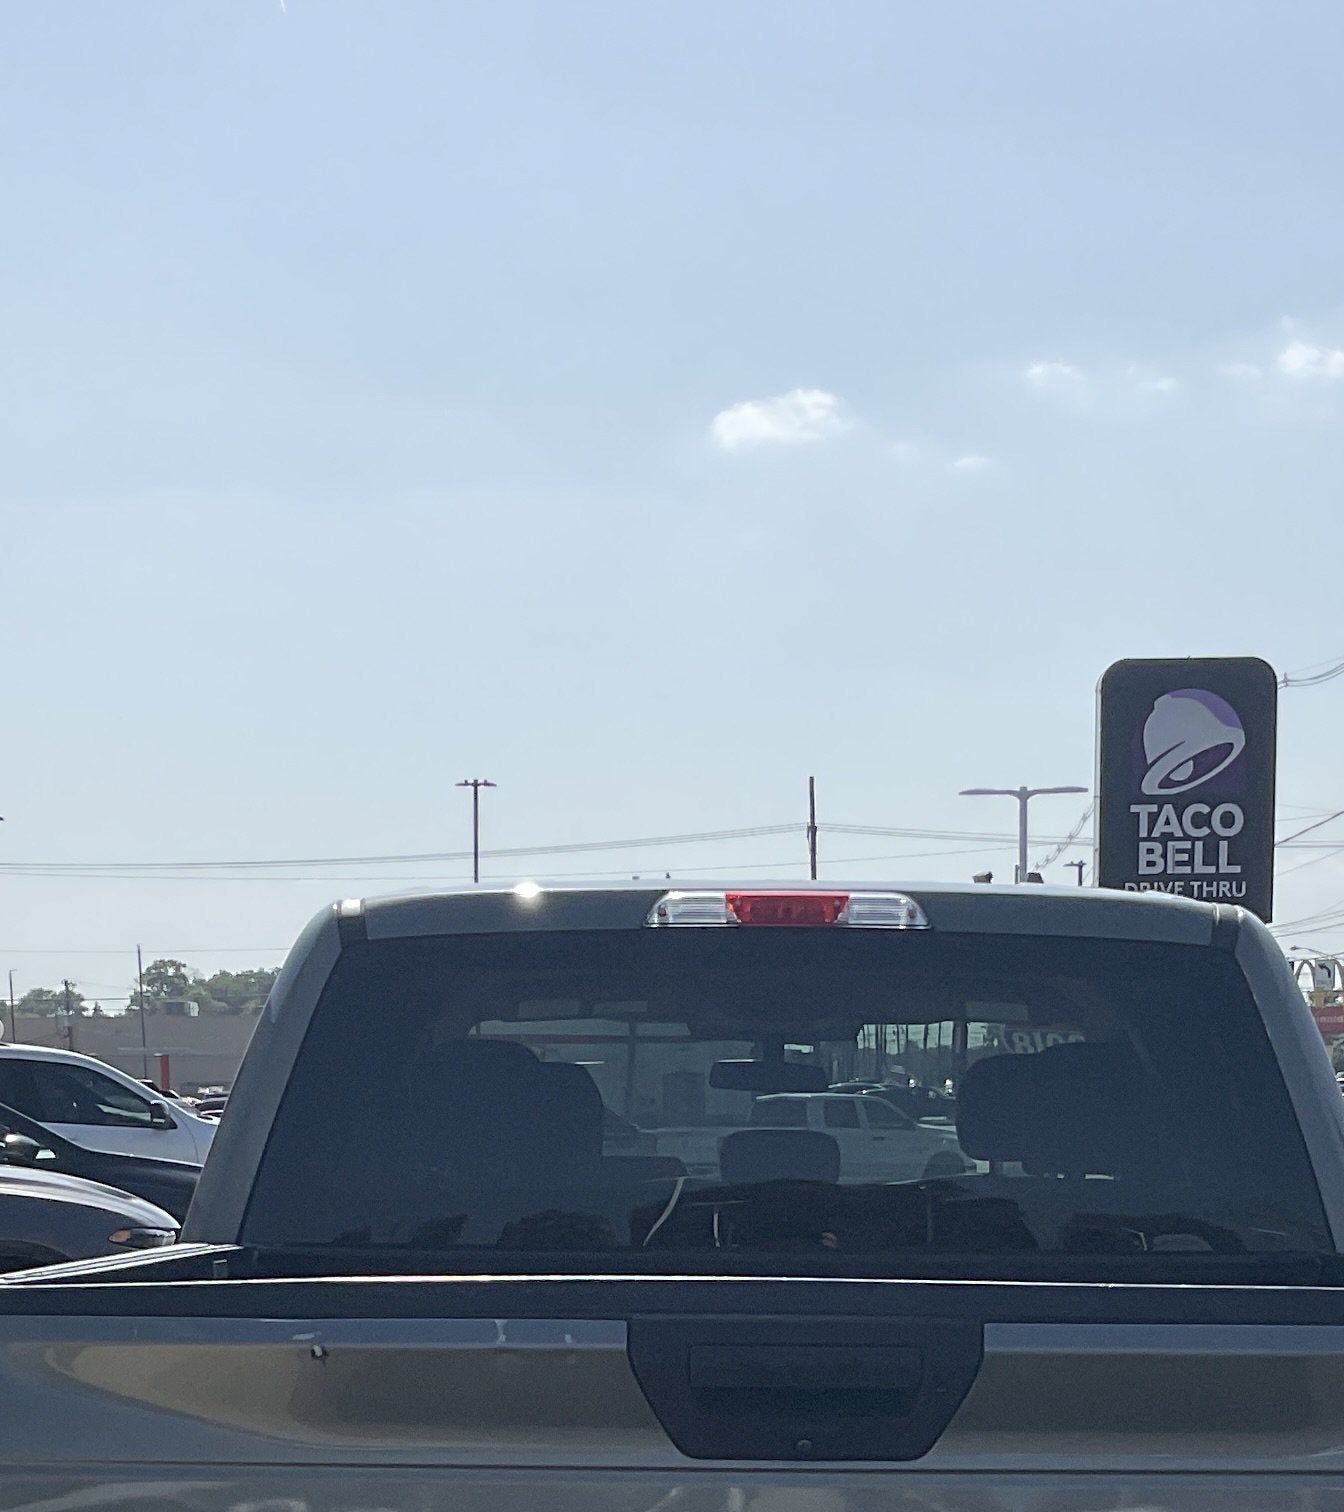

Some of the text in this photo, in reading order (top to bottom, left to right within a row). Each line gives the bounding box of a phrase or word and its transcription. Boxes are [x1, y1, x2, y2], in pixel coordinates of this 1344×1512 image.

[1129, 803, 1244, 837] TACO
[1138, 841, 1241, 875] BELL
[1190, 881, 1246, 897] THRU
